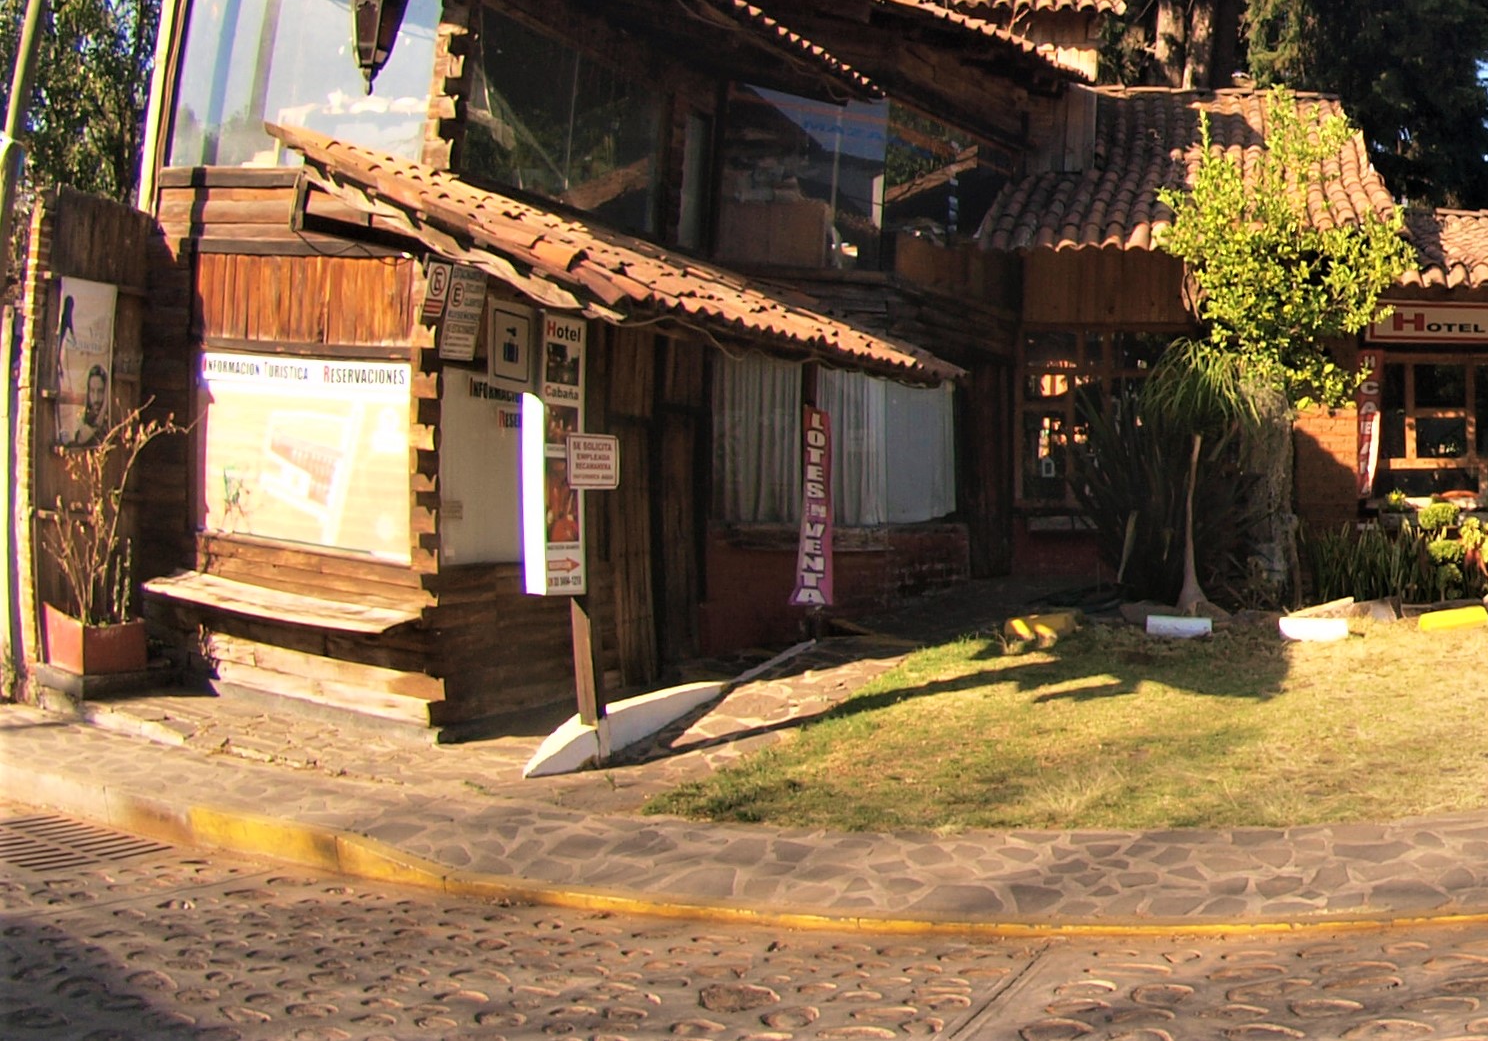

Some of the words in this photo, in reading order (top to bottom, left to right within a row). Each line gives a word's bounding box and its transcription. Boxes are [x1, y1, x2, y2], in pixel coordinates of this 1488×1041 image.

[547, 320, 581, 343] Hotel
[1392, 312, 1486, 333] HOTEL
[202, 358, 260, 375] INFORMACION
[264, 361, 308, 380] TURISTICA
[323, 365, 405, 385] RESERVACIONES
[470, 377, 522, 403] INFORMACIO
[545, 384, 579, 400] Cabaña
[583, 441, 612, 451] SOLICITA
[807, 413, 826, 499] LOTES
[796, 522, 826, 604] VENTA
